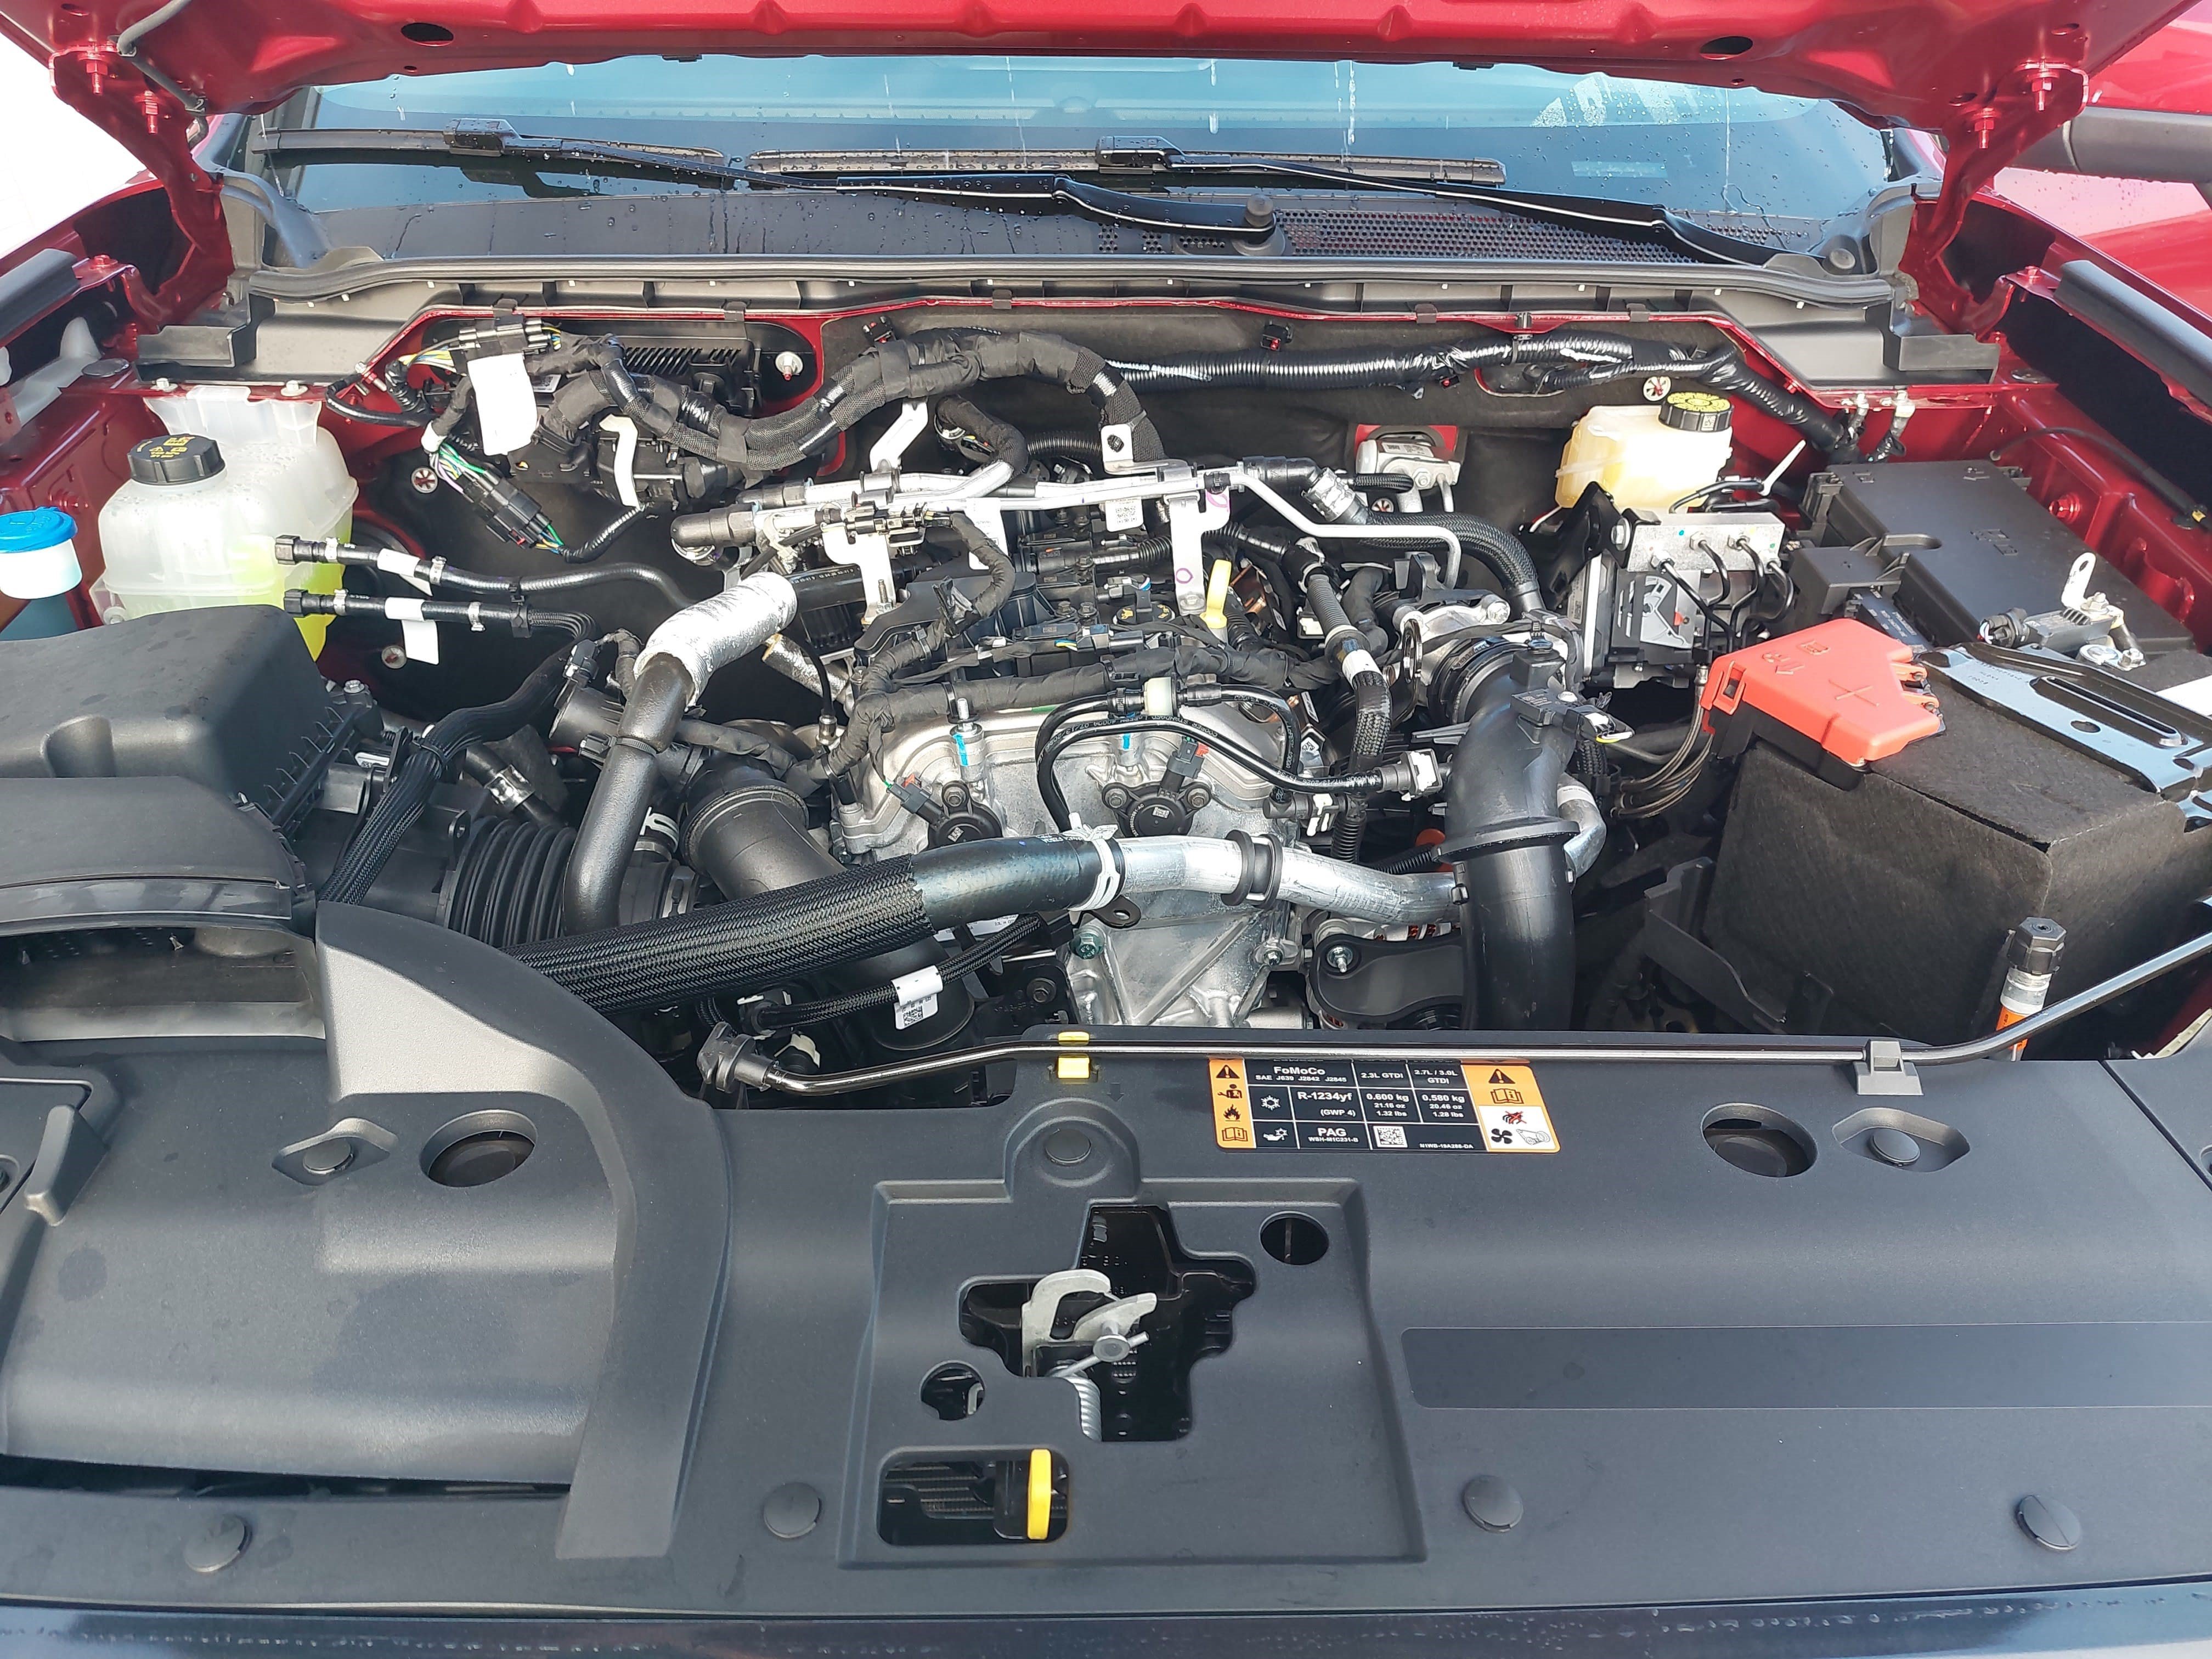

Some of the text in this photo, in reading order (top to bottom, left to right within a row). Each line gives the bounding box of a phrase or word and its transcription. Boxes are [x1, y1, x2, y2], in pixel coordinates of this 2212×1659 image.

[1151, 715, 1189, 724] STANDARD
[1192, 722, 1218, 737] COOPER
[1273, 1066, 1326, 1075] FoMoCo
[1297, 1091, 1353, 1102] R-1234yf
[1396, 1093, 1410, 1102] kg
[1452, 1095, 1465, 1103] kg
[1317, 1127, 1347, 1137] PAG
